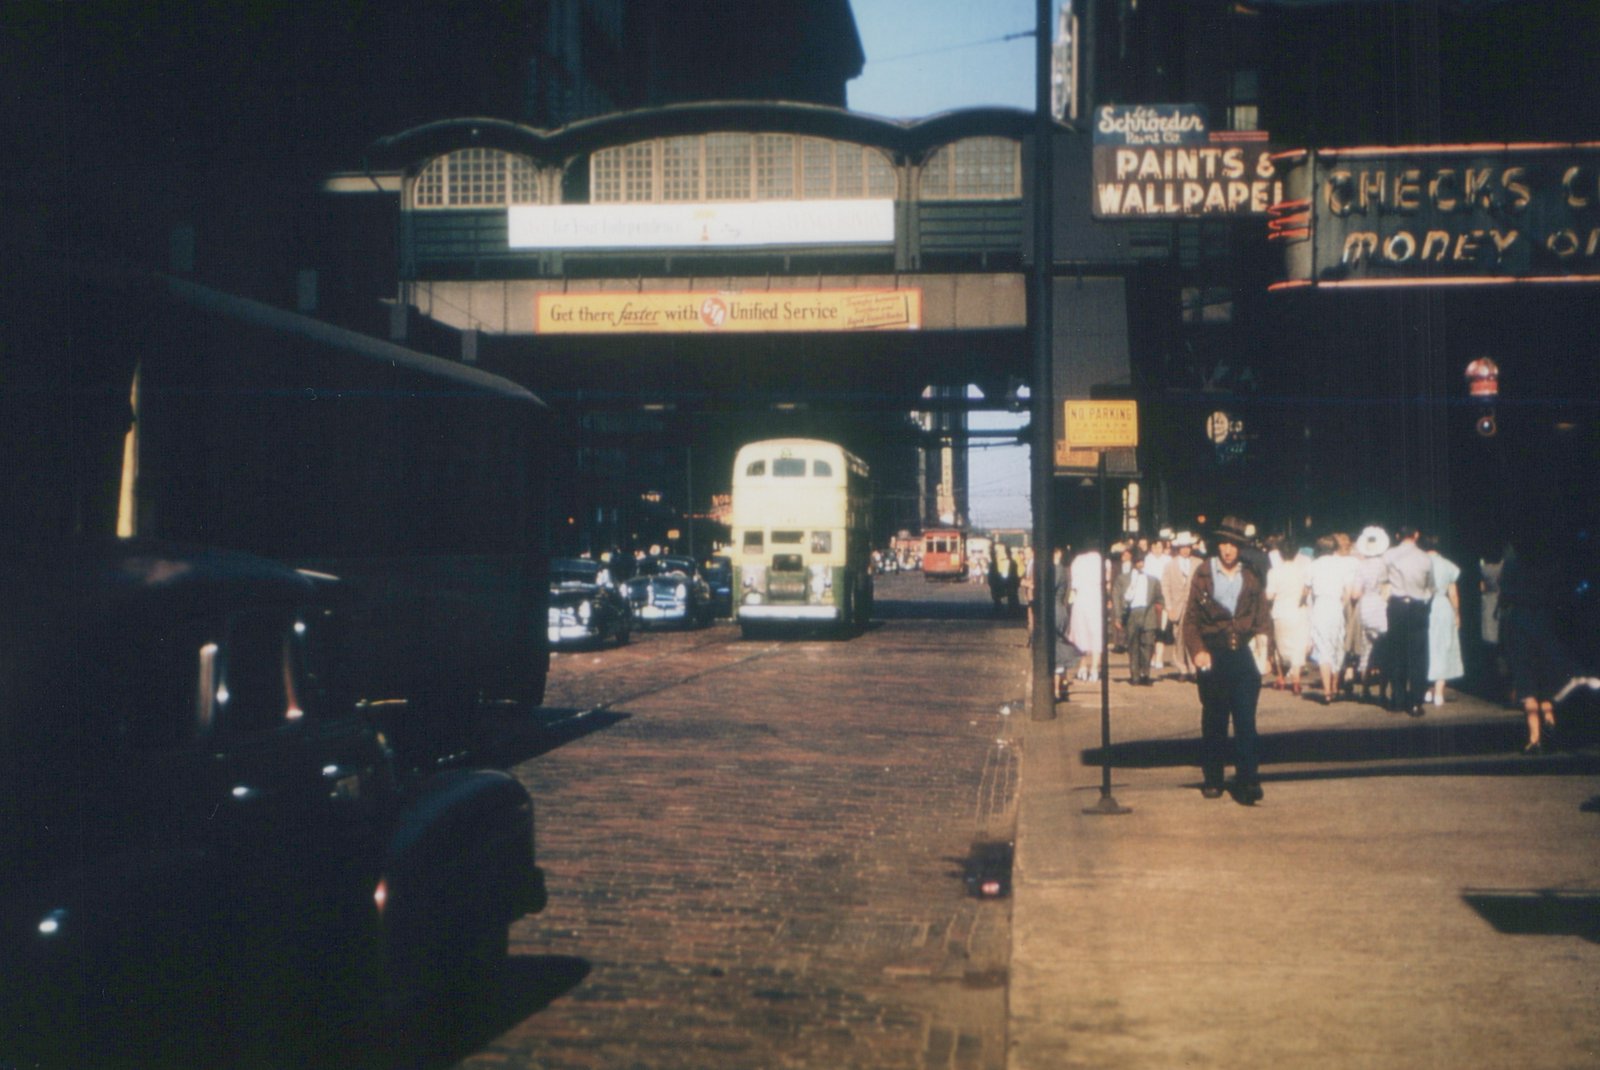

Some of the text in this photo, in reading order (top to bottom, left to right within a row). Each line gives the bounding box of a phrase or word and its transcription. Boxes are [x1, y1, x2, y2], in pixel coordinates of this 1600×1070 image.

[1098, 106, 1204, 133] Schroeder
[1125, 131, 1160, 144] Paint
[1116, 148, 1275, 180] PAINTS &
[1322, 166, 1600, 214] CHECKS C
[549, 304, 573, 322] Get
[578, 305, 615, 322] there
[611, 301, 661, 327] faster
[664, 304, 699, 321] with
[702, 297, 726, 327] CTA
[729, 301, 779, 320] Unified
[783, 301, 838, 321] Service
